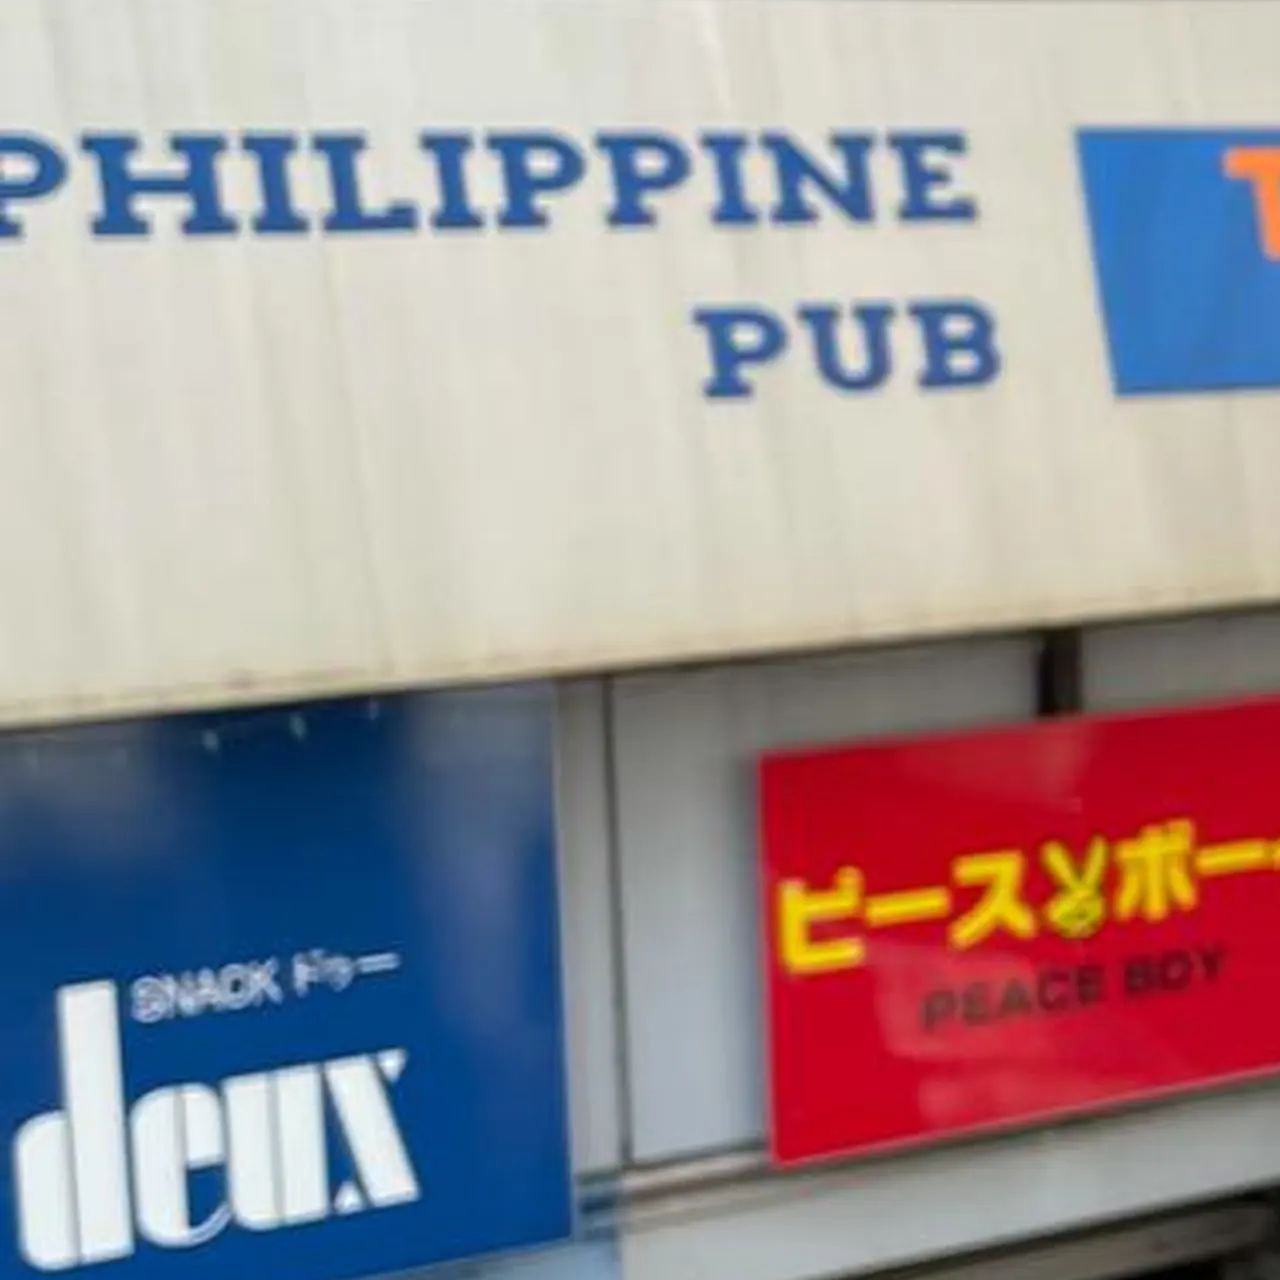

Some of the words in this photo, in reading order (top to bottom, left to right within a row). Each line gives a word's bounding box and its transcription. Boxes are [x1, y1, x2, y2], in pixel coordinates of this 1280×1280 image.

[0, 128, 979, 239] PHILIPPINE
[692, 298, 1003, 399] PUB
[130, 959, 283, 1024] SNACK
[920, 964, 1105, 1035] PEACE
[1124, 939, 1230, 998] BOY
[14, 978, 422, 1272] deux
